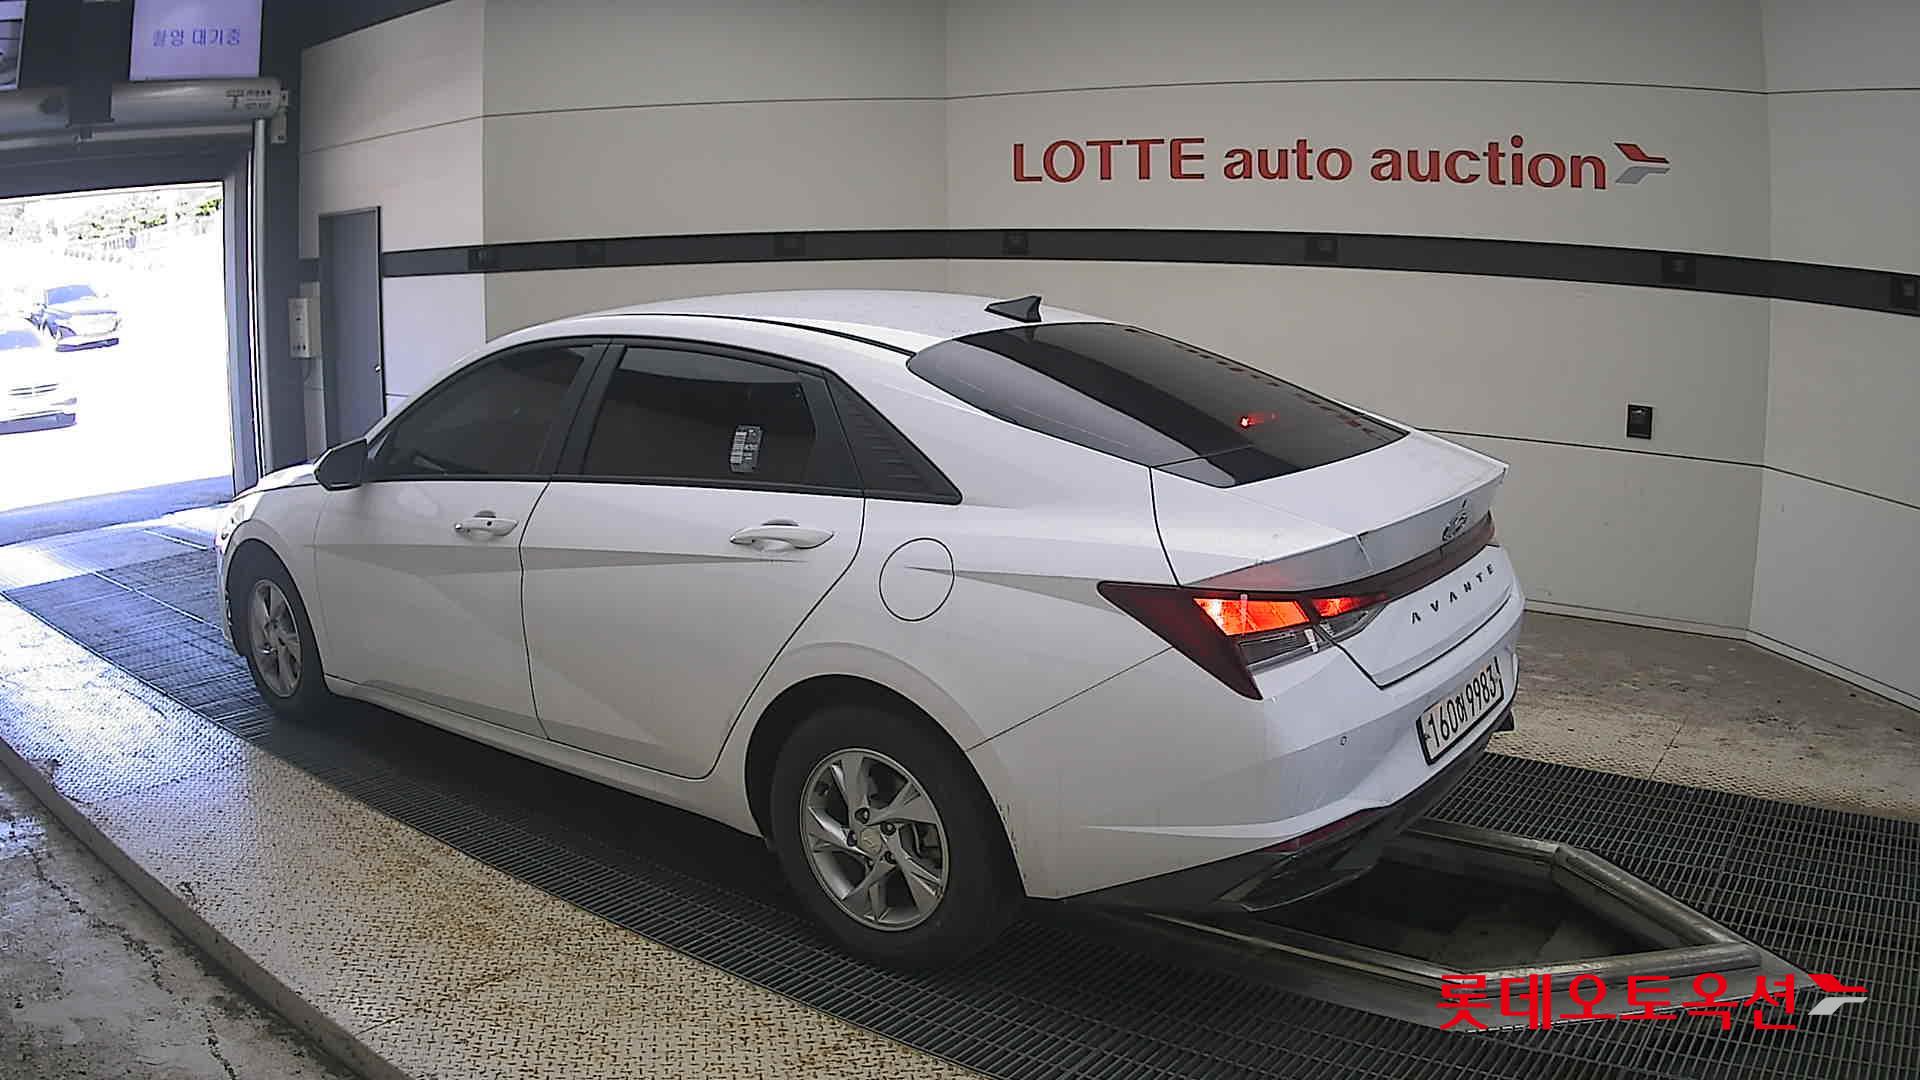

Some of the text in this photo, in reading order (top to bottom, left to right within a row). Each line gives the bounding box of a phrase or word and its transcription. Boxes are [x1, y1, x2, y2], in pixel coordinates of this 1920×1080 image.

[1012, 135, 1607, 190] LOTTE auto auction
[1411, 563, 1495, 625] AVANTE
